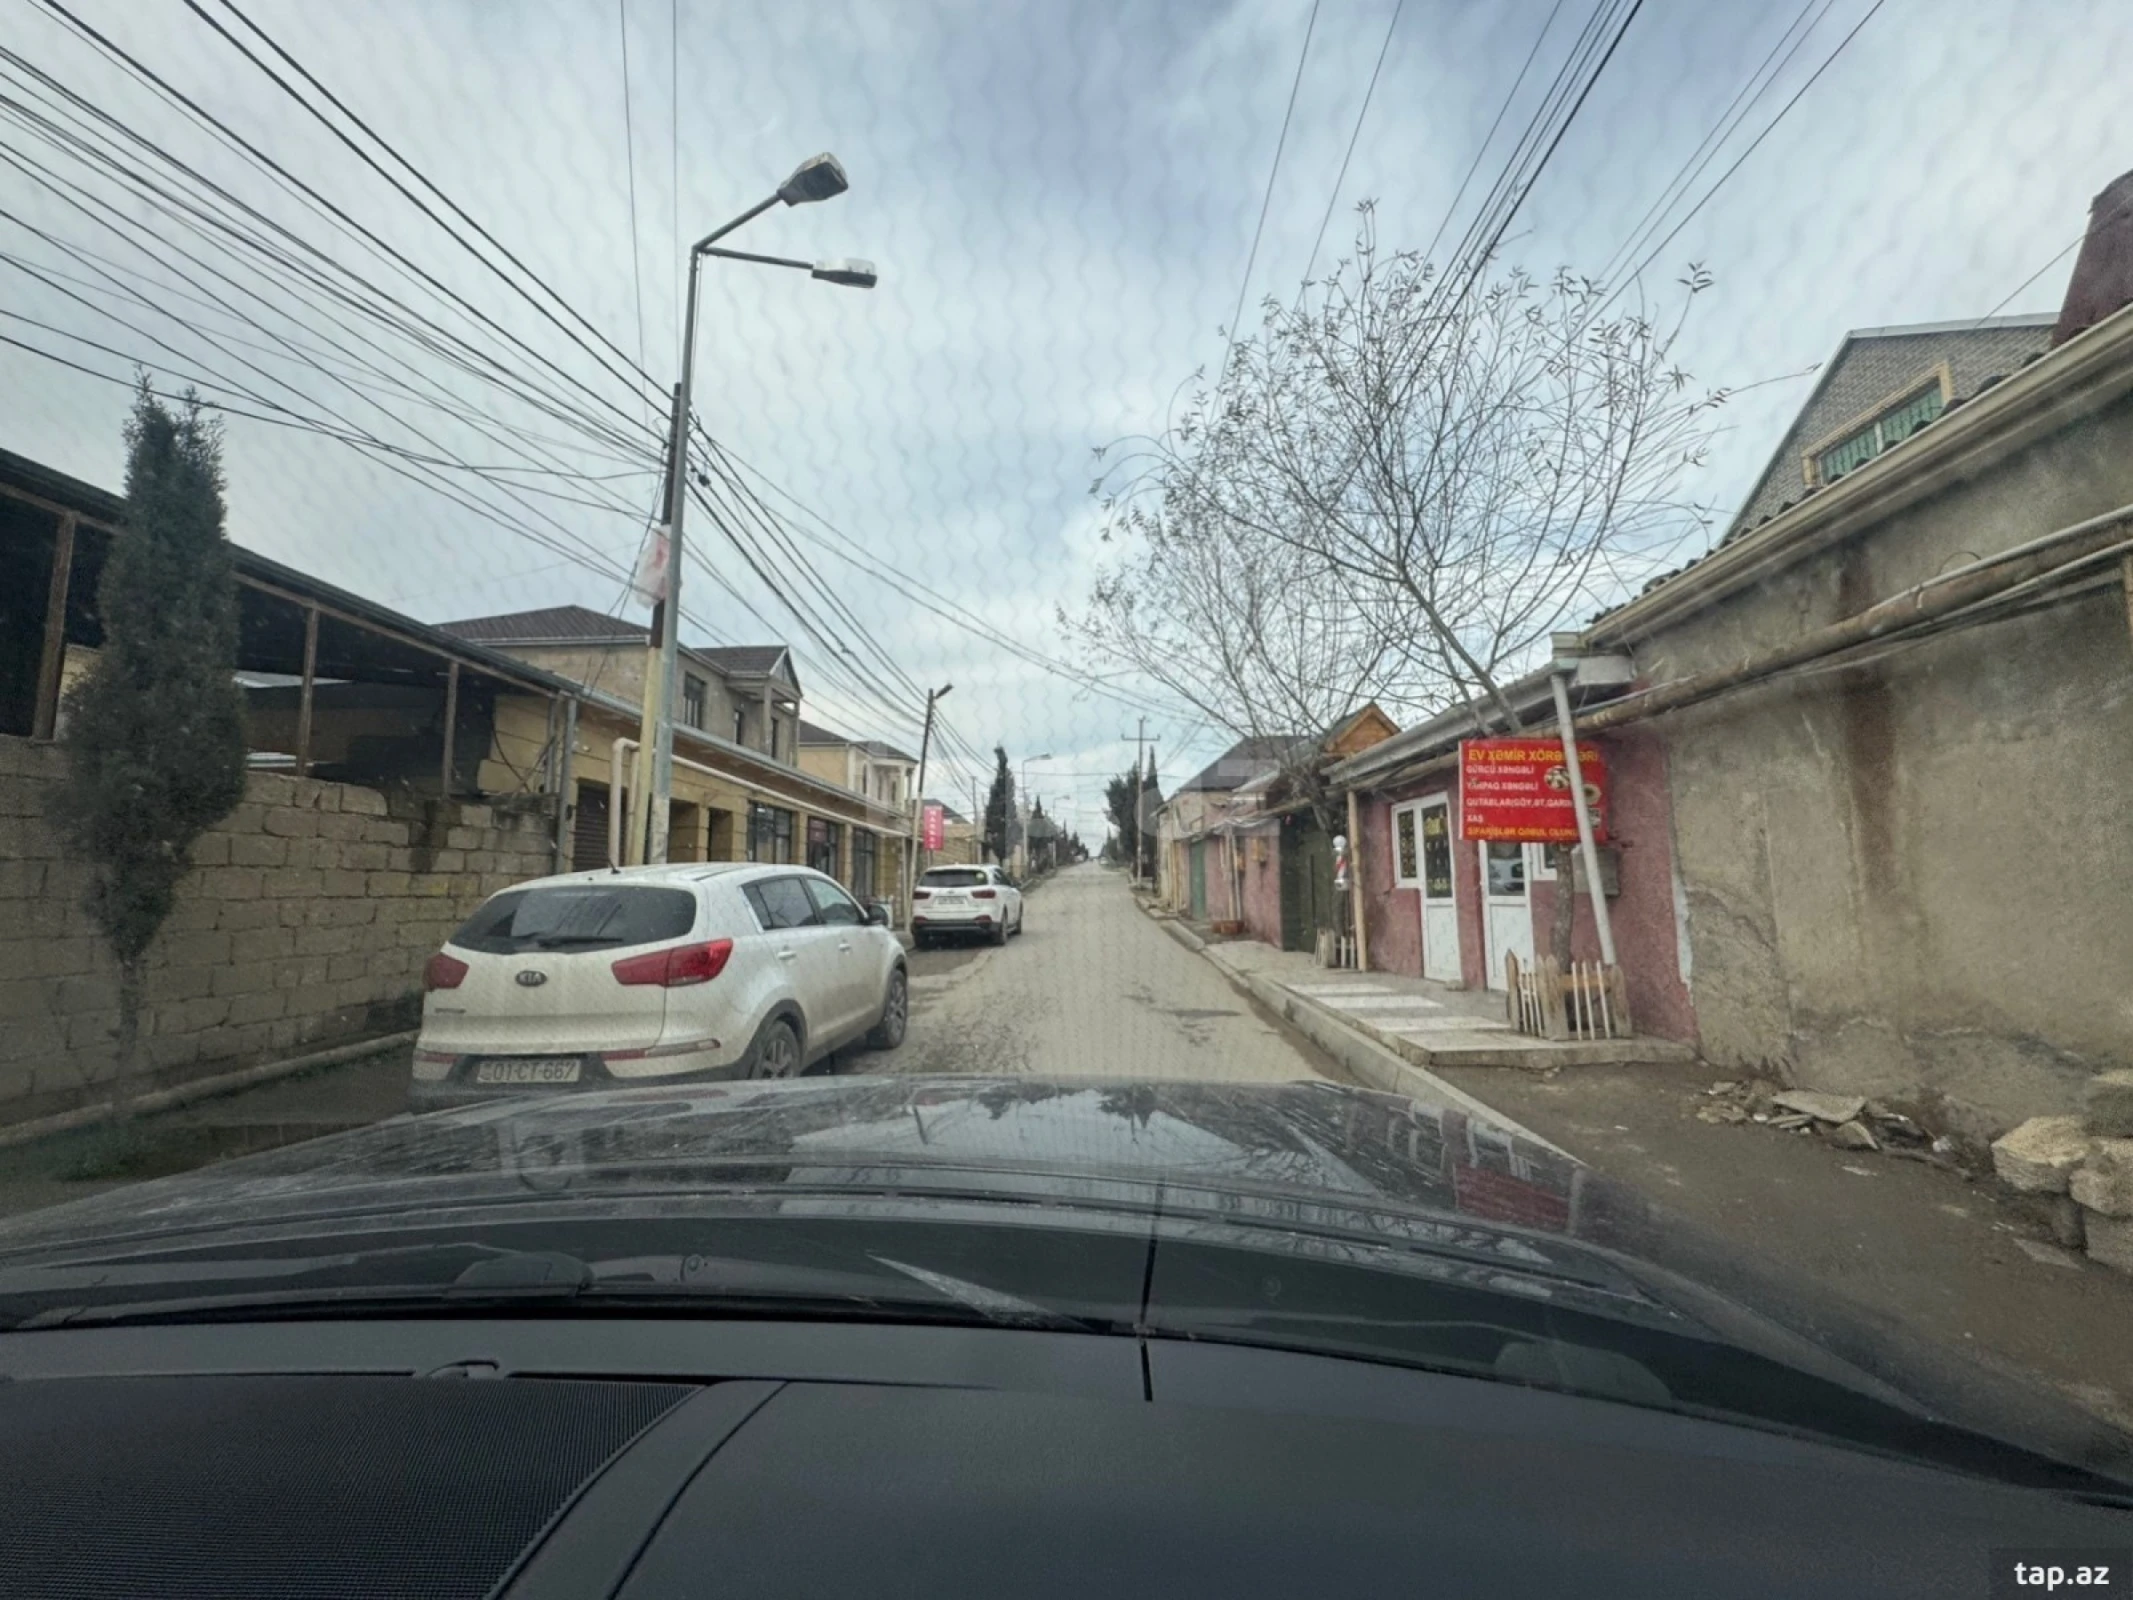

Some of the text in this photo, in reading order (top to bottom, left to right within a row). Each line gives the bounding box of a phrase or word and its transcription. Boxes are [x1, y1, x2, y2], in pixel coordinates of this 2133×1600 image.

[1468, 748, 1598, 762] EV XƏMİR XÖRƏƏRİ
[518, 971, 542, 984] KIA
